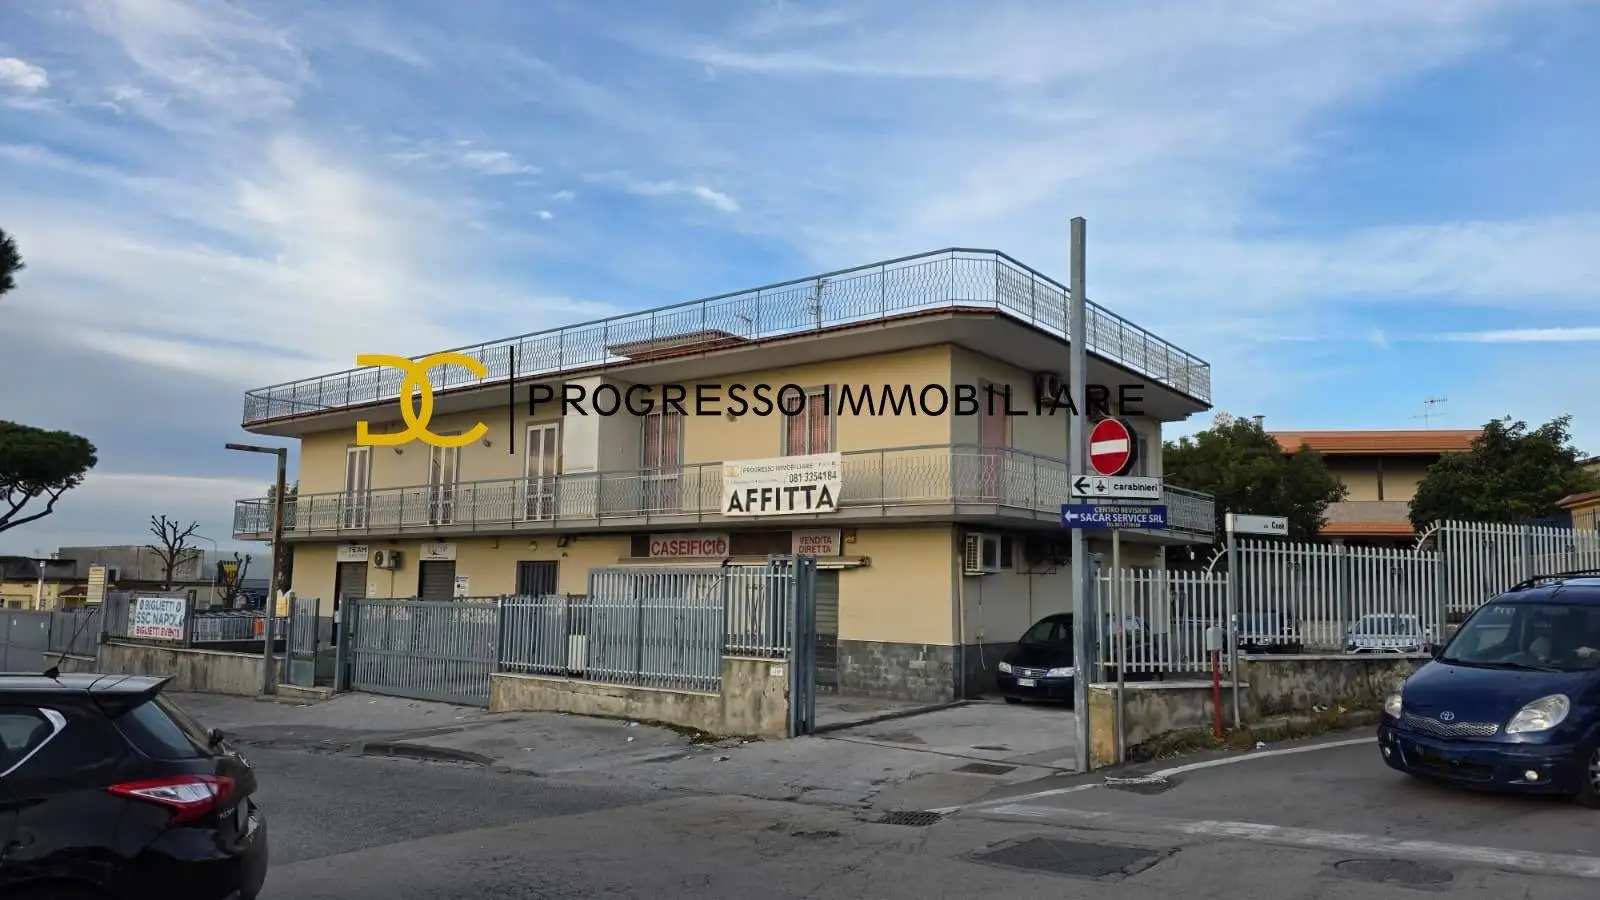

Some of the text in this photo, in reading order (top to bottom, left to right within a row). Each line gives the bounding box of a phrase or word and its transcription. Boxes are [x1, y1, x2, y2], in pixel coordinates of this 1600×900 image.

[789, 473, 802, 483] 081
[804, 470, 837, 482] 3354184
[1113, 483, 1158, 492] carabinieri
[727, 484, 834, 512] AFFITTA
[1080, 513, 1164, 523] SACAR SERVICE SRL
[799, 536, 832, 545] VENDITA
[650, 538, 726, 556] CASEIFICIO
[798, 545, 832, 554] DIRETTA
[136, 611, 151, 624] SSC
[136, 625, 160, 636] BIGLIETTI
